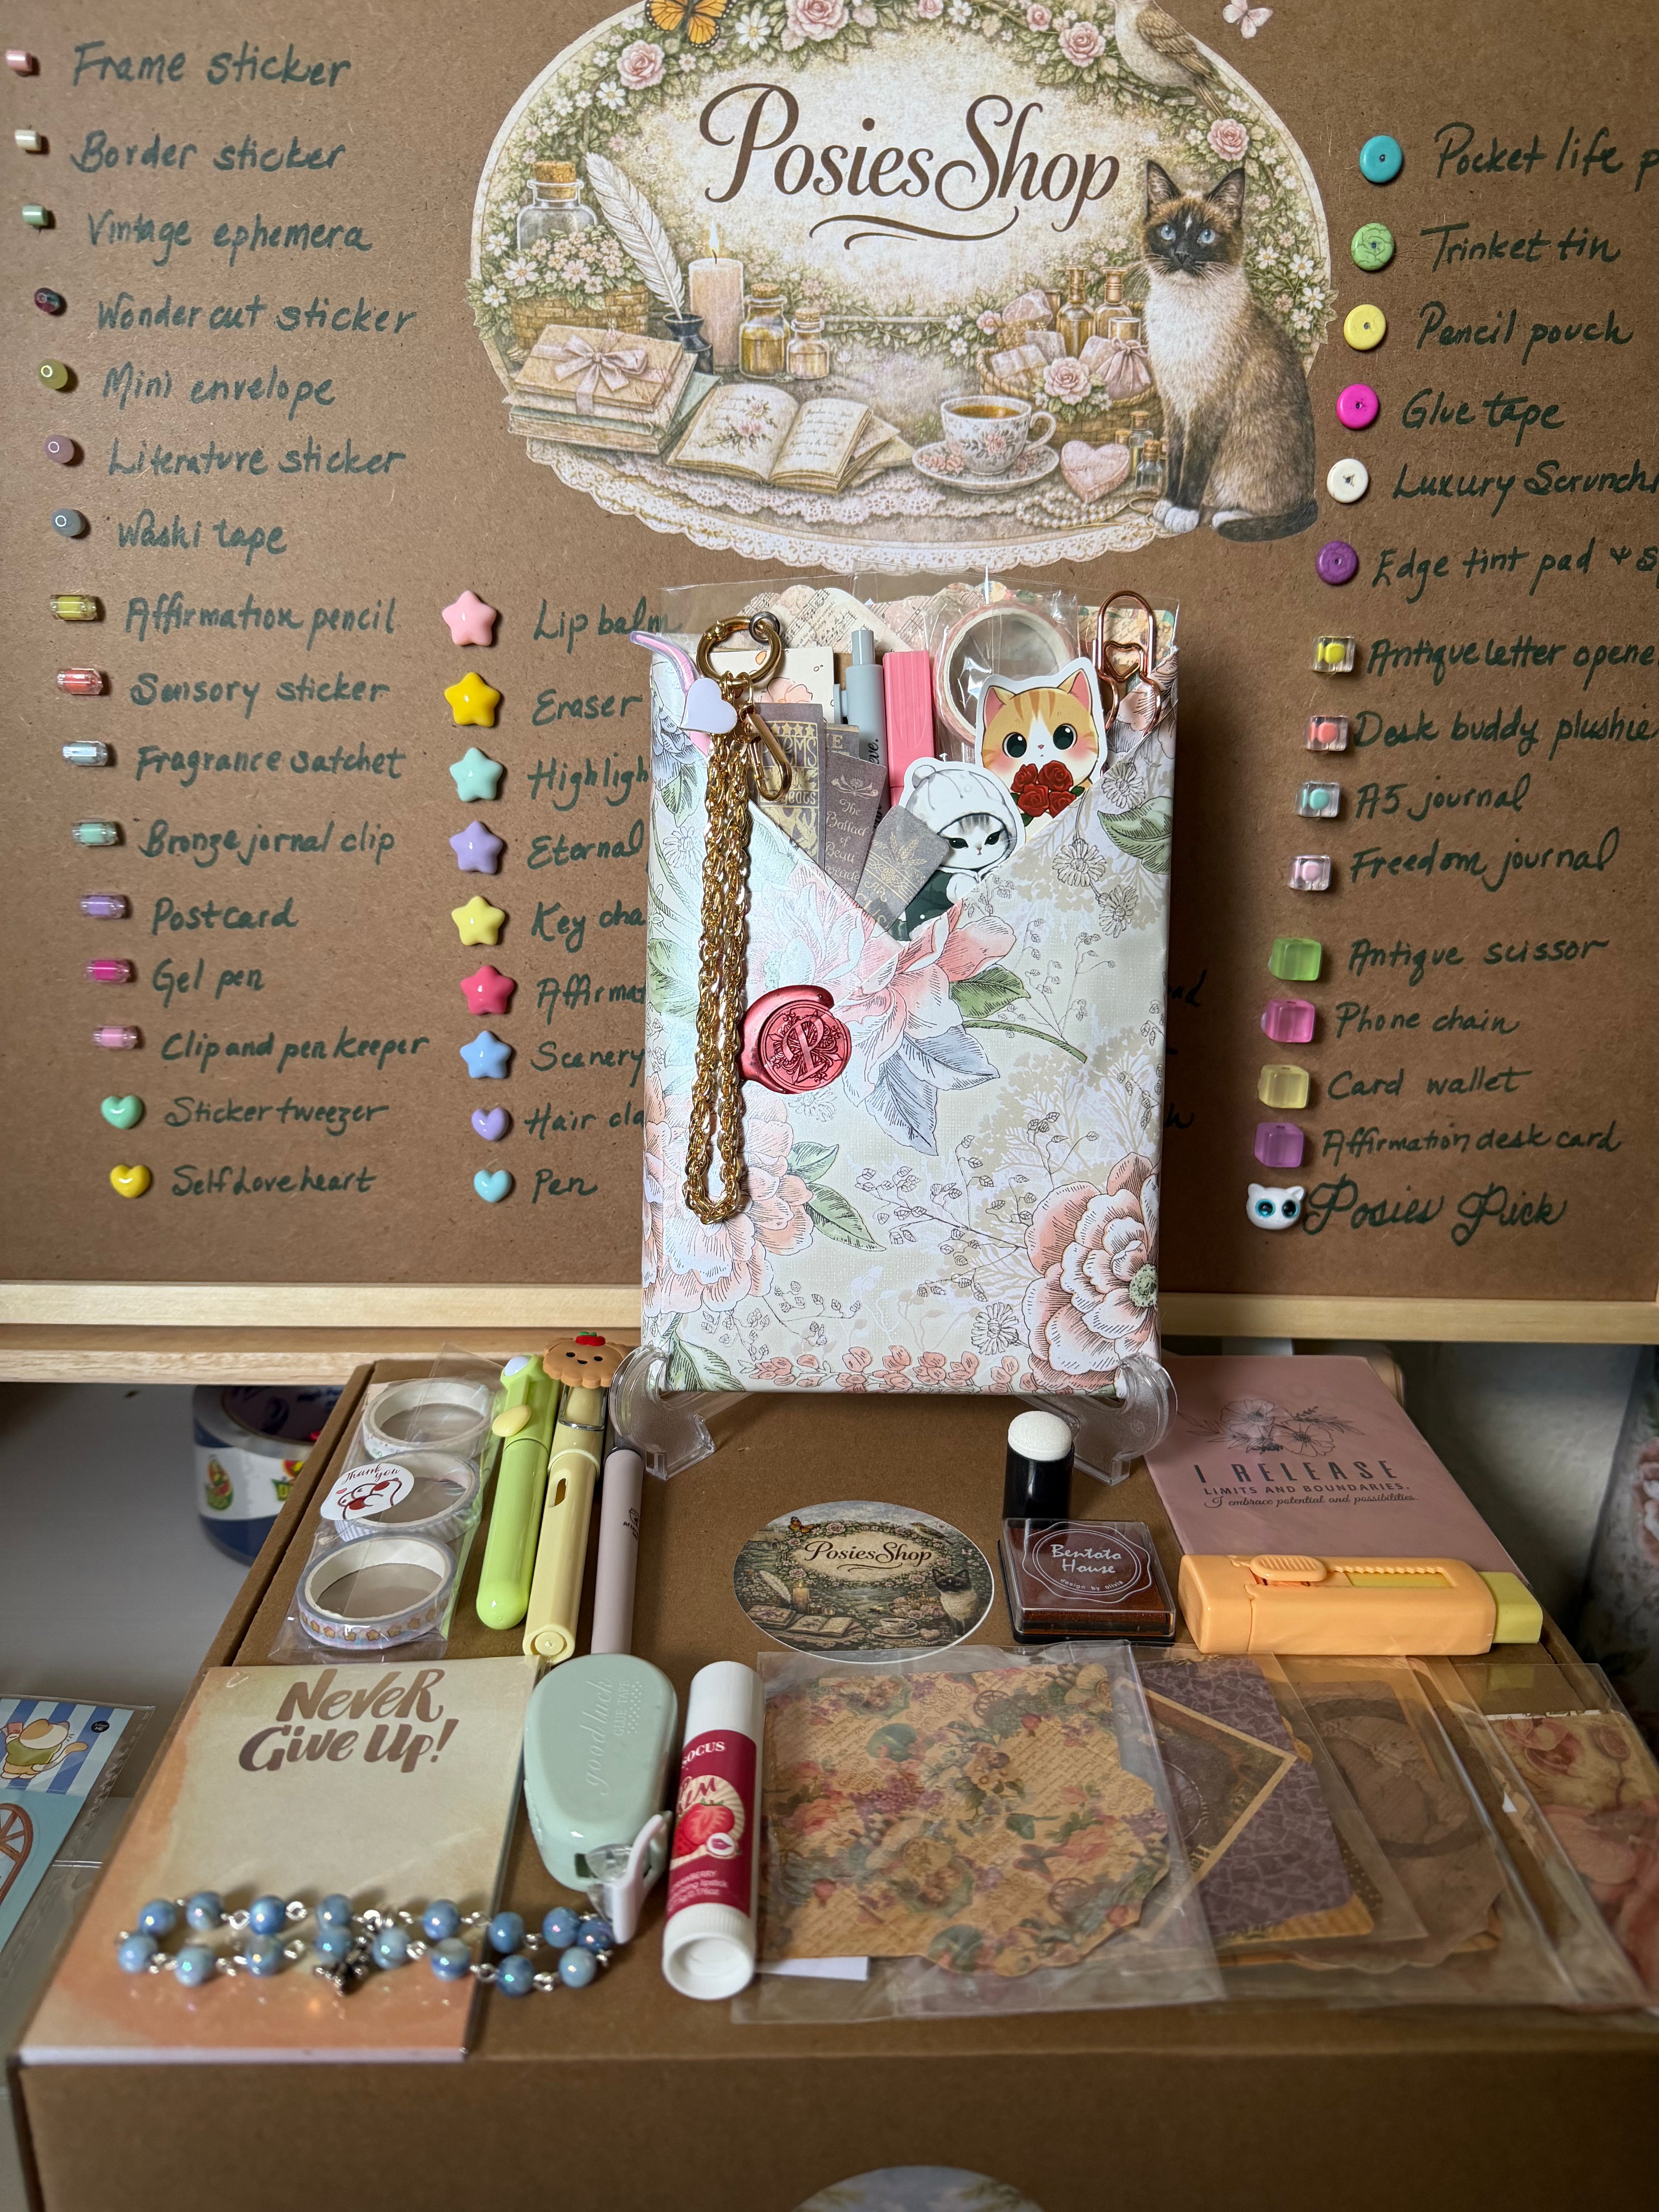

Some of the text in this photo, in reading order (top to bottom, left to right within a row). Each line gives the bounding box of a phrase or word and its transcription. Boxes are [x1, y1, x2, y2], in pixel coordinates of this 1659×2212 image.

[73, 40, 350, 87] Frame sticker
[70, 129, 345, 174] Border sticker
[1437, 122, 1546, 177] Pocket
[1555, 127, 1623, 175] life
[87, 210, 372, 267] Vintage ephemera
[1420, 223, 1620, 271] Trinket tin
[97, 292, 416, 334] Wonder cut sticker
[1417, 301, 1632, 365] Pencil pouch
[102, 361, 334, 422] Mini envelope
[1401, 388, 1563, 446] Glue tape
[108, 437, 406, 476] Literature sticker
[1392, 465, 1515, 517] Luxury
[212, 520, 286, 567] tape
[1371, 549, 1448, 604] Edge
[1462, 547, 1526, 578] tint
[1529, 540, 1594, 597] pad
[124, 591, 395, 651] Affirmation pencil
[532, 601, 588, 655] Lip
[1367, 637, 1659, 690] Antique letter opene
[276, 673, 390, 703] sticker
[531, 689, 642, 727] Eraser
[1355, 711, 1438, 748] Desk
[1450, 707, 1538, 757] buddy
[135, 743, 406, 788] Fragrance satchet
[839, 799, 861, 816] The
[1354, 774, 1530, 823] A5 journal
[138, 819, 244, 869] Bronze
[339, 822, 394, 866] clip
[826, 811, 870, 837] Ballad
[840, 836, 851, 848] of
[1350, 827, 1619, 893] Freedom journal
[531, 902, 586, 954] Key
[151, 959, 264, 1009] Gel pen
[1348, 939, 1608, 987] Antique scissor
[1335, 1001, 1519, 1039] Phone chain
[160, 1027, 429, 1074] Clip and pen keeper
[530, 1041, 646, 1088] Scenery
[1327, 1067, 1532, 1101] Card wallet
[164, 1096, 389, 1138] Sticker tweezer
[524, 1104, 595, 1141] Hair
[1321, 1124, 1620, 1166] Affirmation desk card
[298, 1168, 376, 1193] heart
[531, 1169, 597, 1204] Pen
[342, 1463, 383, 1484] Thank
[374, 1468, 400, 1482] you
[1194, 1460, 1397, 1483] I RELEASE
[1203, 1487, 1258, 1495] LIMITS
[1303, 1483, 1410, 1492] BOUNDARIES.
[1228, 1498, 1273, 1506] embrace
[1276, 1495, 1325, 1507] potential
[1328, 1494, 1351, 1503] and
[1354, 1493, 1419, 1504] possibilities.
[1060, 1578, 1086, 1589] design
[1105, 1580, 1124, 1589] olivia
[1062, 1558, 1116, 1573] House
[613, 1681, 630, 1736] GLUE TAPE
[238, 1718, 460, 1773] Give Up!
[580, 1677, 613, 1796] good luck
